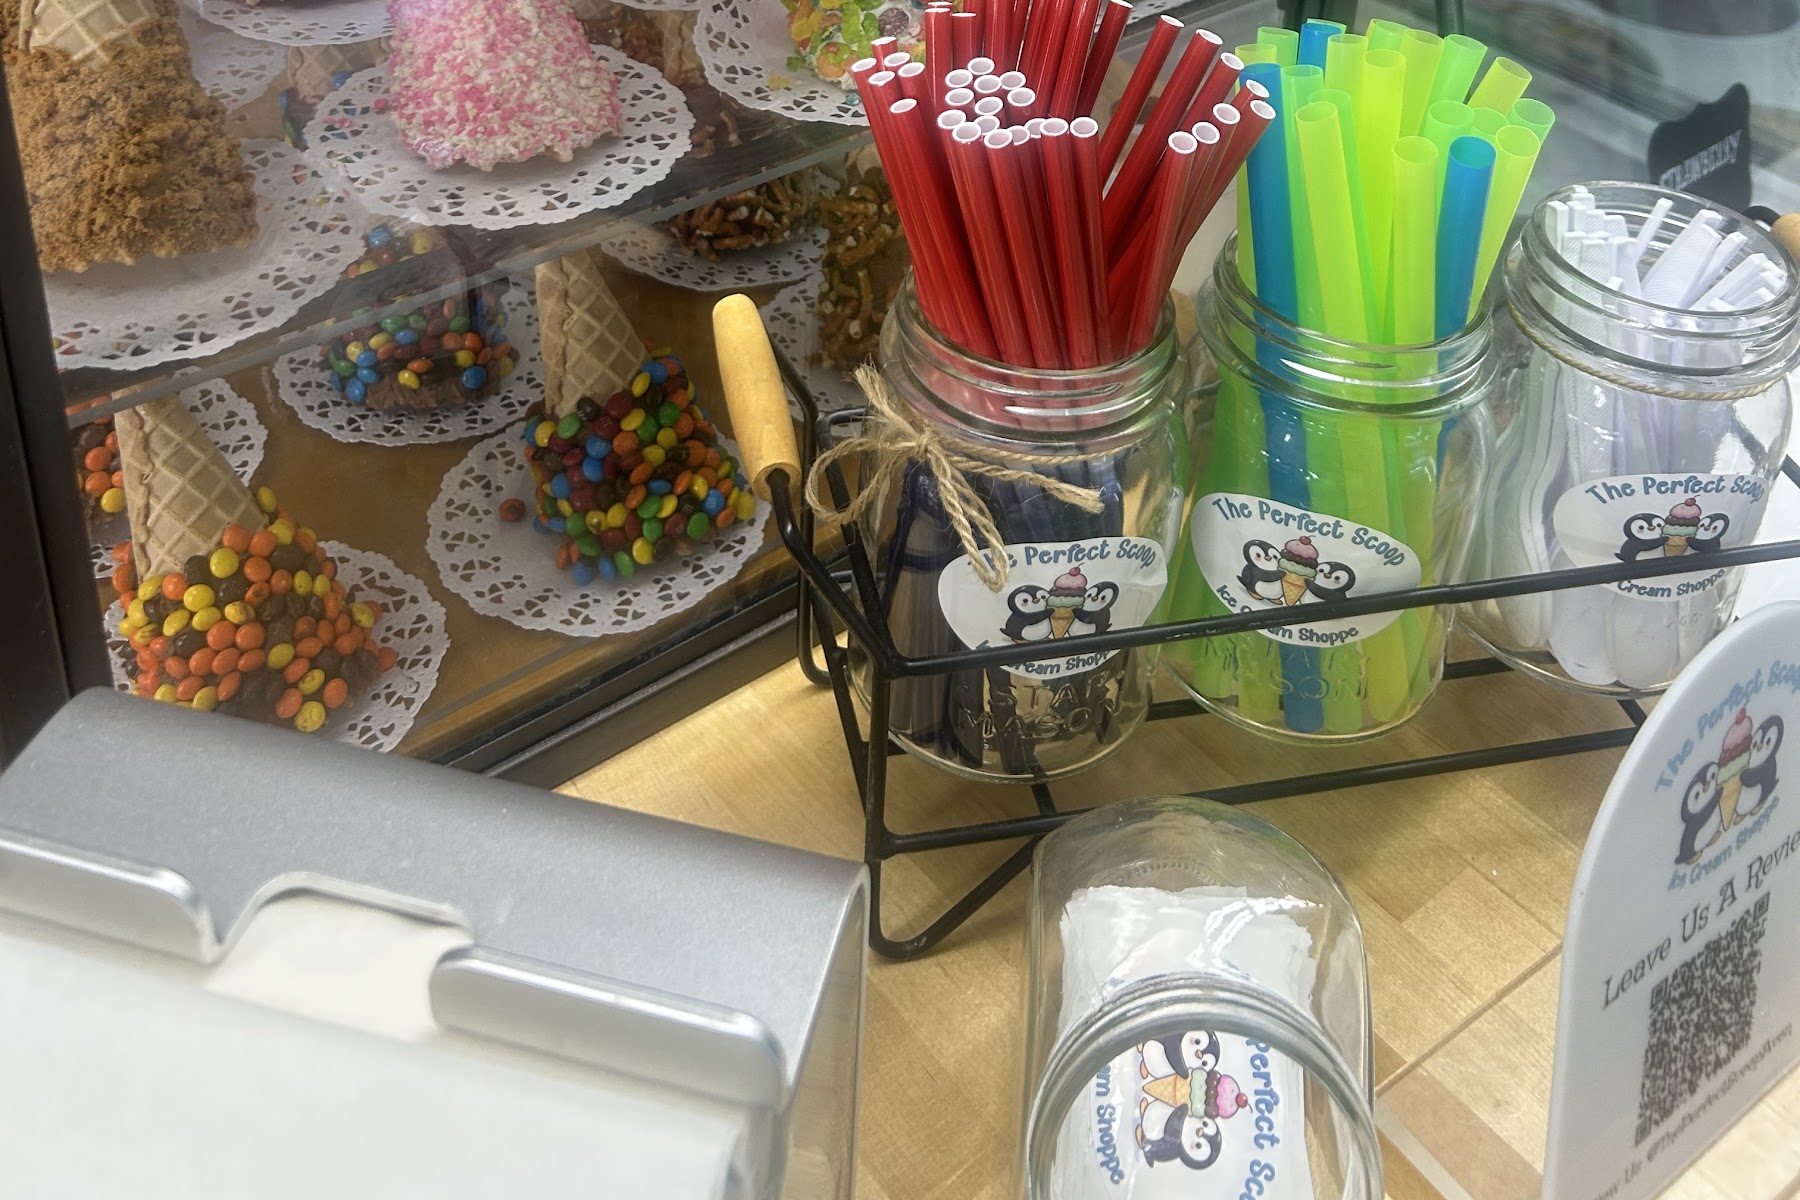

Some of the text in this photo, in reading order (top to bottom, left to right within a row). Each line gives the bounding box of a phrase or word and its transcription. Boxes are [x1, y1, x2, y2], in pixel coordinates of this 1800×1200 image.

[1585, 481, 1636, 504] The
[1642, 475, 1726, 495] Perfect
[1024, 539, 1110, 566] Perfect
[1116, 538, 1156, 569] Scoop
[1212, 497, 1405, 567] The Perfect Scoop
[1216, 584, 1238, 608] Ice
[1298, 626, 1360, 646] Shoppe
[1617, 568, 1726, 598] Cream Shoppe
[1654, 738, 1694, 792] The
[1697, 668, 1764, 741] Perfect
[1602, 937, 1672, 1010] Leave
[1681, 903, 1711, 943] Us
[1716, 875, 1738, 916] A
[1096, 1103, 1126, 1185] Shoppe
